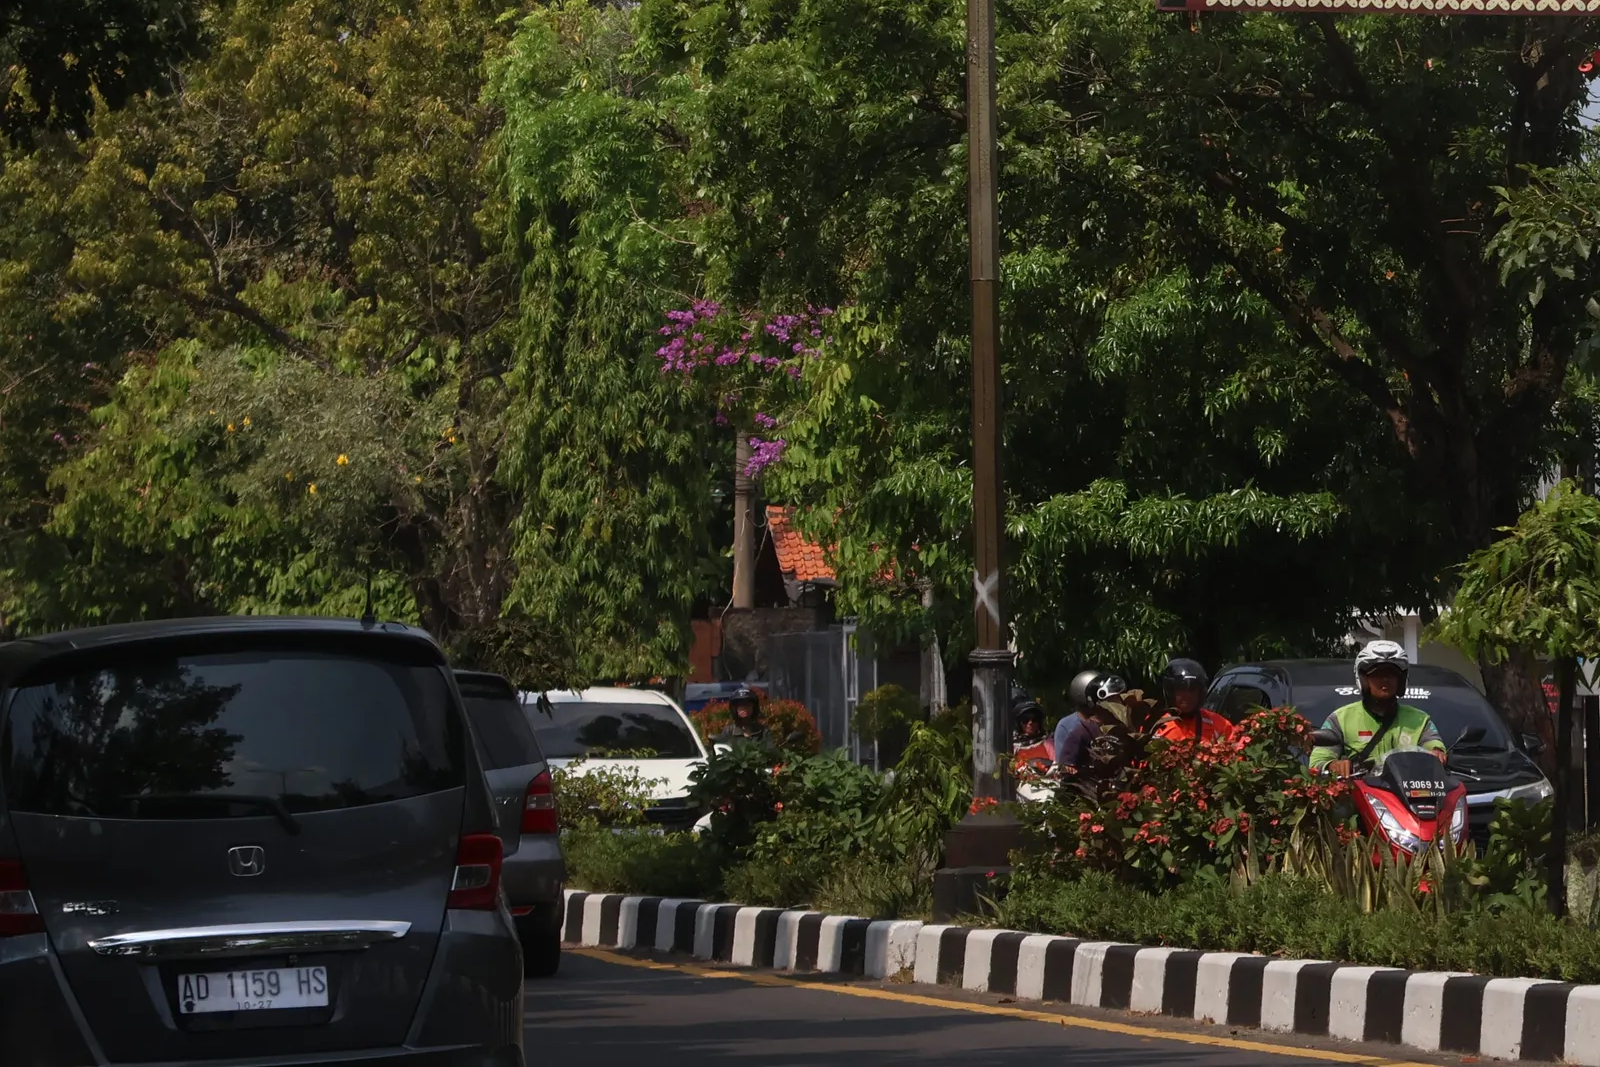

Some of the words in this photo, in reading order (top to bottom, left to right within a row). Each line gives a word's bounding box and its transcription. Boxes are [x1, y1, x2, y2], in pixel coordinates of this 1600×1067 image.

[1402, 780, 1409, 789] K
[1410, 780, 1432, 789] 3069
[183, 974, 209, 1001] AD
[227, 970, 281, 998] 1159
[297, 968, 326, 995] HS
[236, 999, 273, 1010] 10-27
